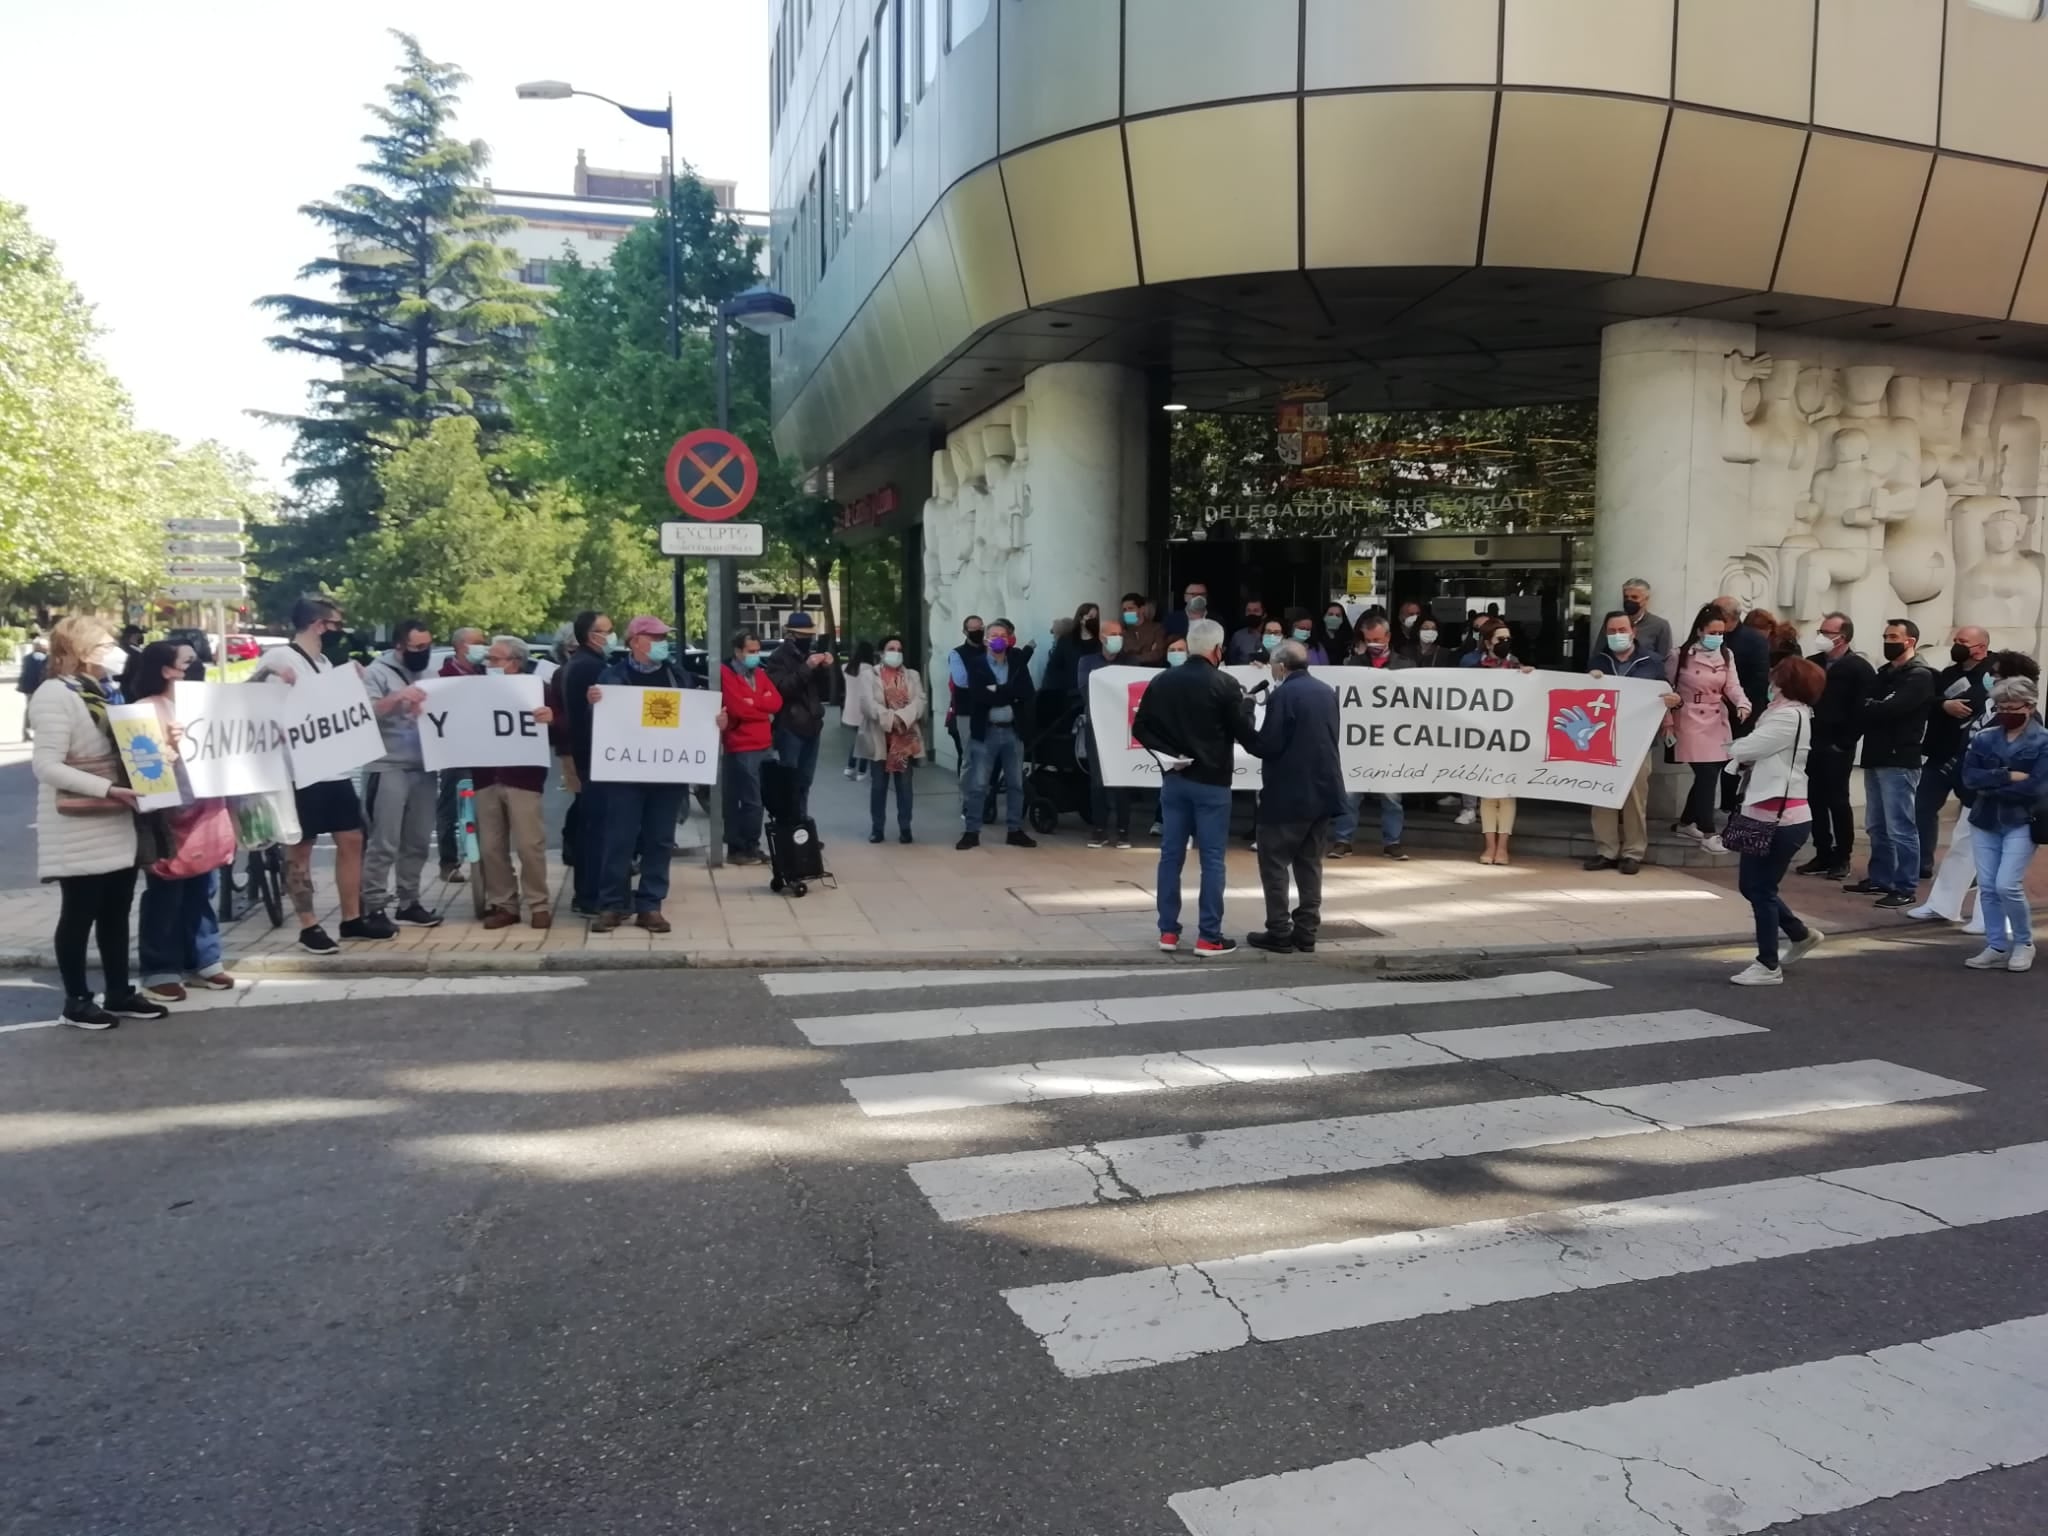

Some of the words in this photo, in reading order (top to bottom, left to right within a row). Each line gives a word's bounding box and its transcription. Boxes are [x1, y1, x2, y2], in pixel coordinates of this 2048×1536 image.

[1372, 685, 1516, 712] SANIDAD
[287, 702, 372, 749] PÚBLICA
[426, 711, 449, 738] Y
[492, 710, 539, 738] DE
[1345, 724, 1385, 747] DE
[1393, 725, 1532, 752] CALIDAD
[183, 718, 282, 763] SANIDAD
[604, 746, 707, 764] CALIDAD
[1348, 763, 1429, 781] sanidad
[1431, 765, 1518, 787] pública
[1528, 769, 1617, 795] Zamora
